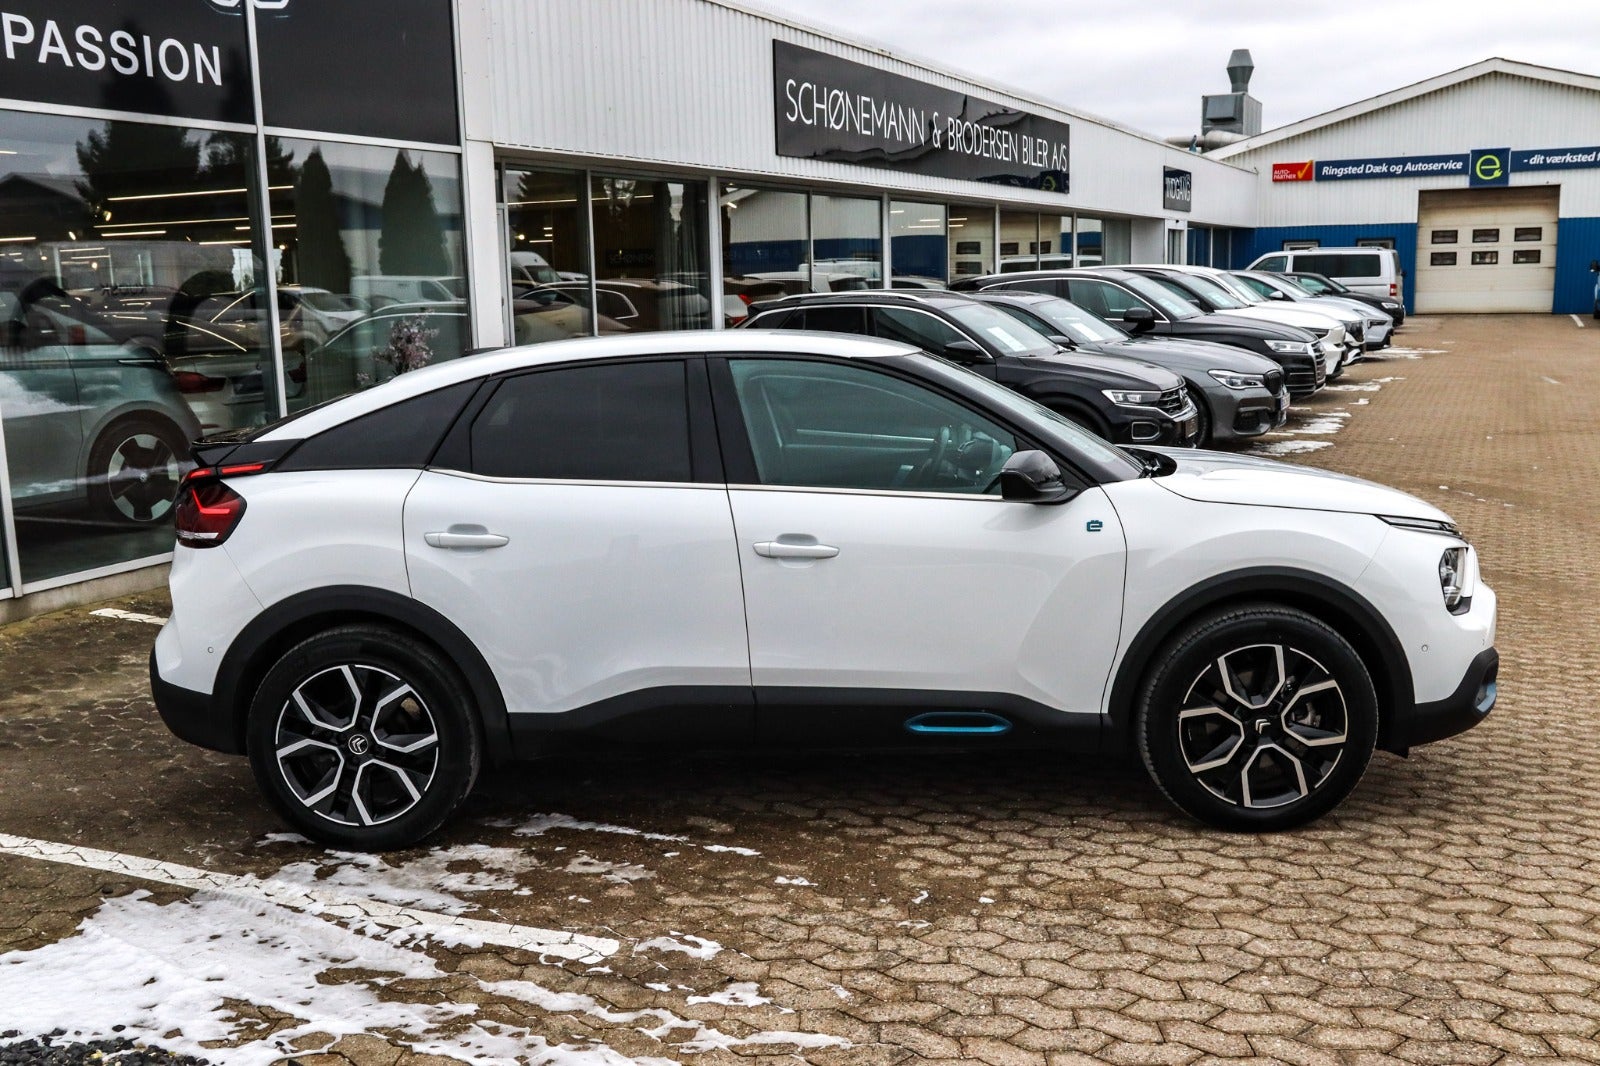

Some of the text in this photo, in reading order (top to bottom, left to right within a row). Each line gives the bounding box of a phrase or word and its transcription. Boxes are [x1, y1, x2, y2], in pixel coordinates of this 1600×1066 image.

[1, 12, 223, 87] PASSION
[785, 78, 1068, 172] SCHØNEMANN & BRODERSEN BILER A/S
[1322, 160, 1463, 177] Ringsted Dæk og Autoservice
[1529, 154, 1545, 165] dit
[1545, 151, 1597, 164] værksted
